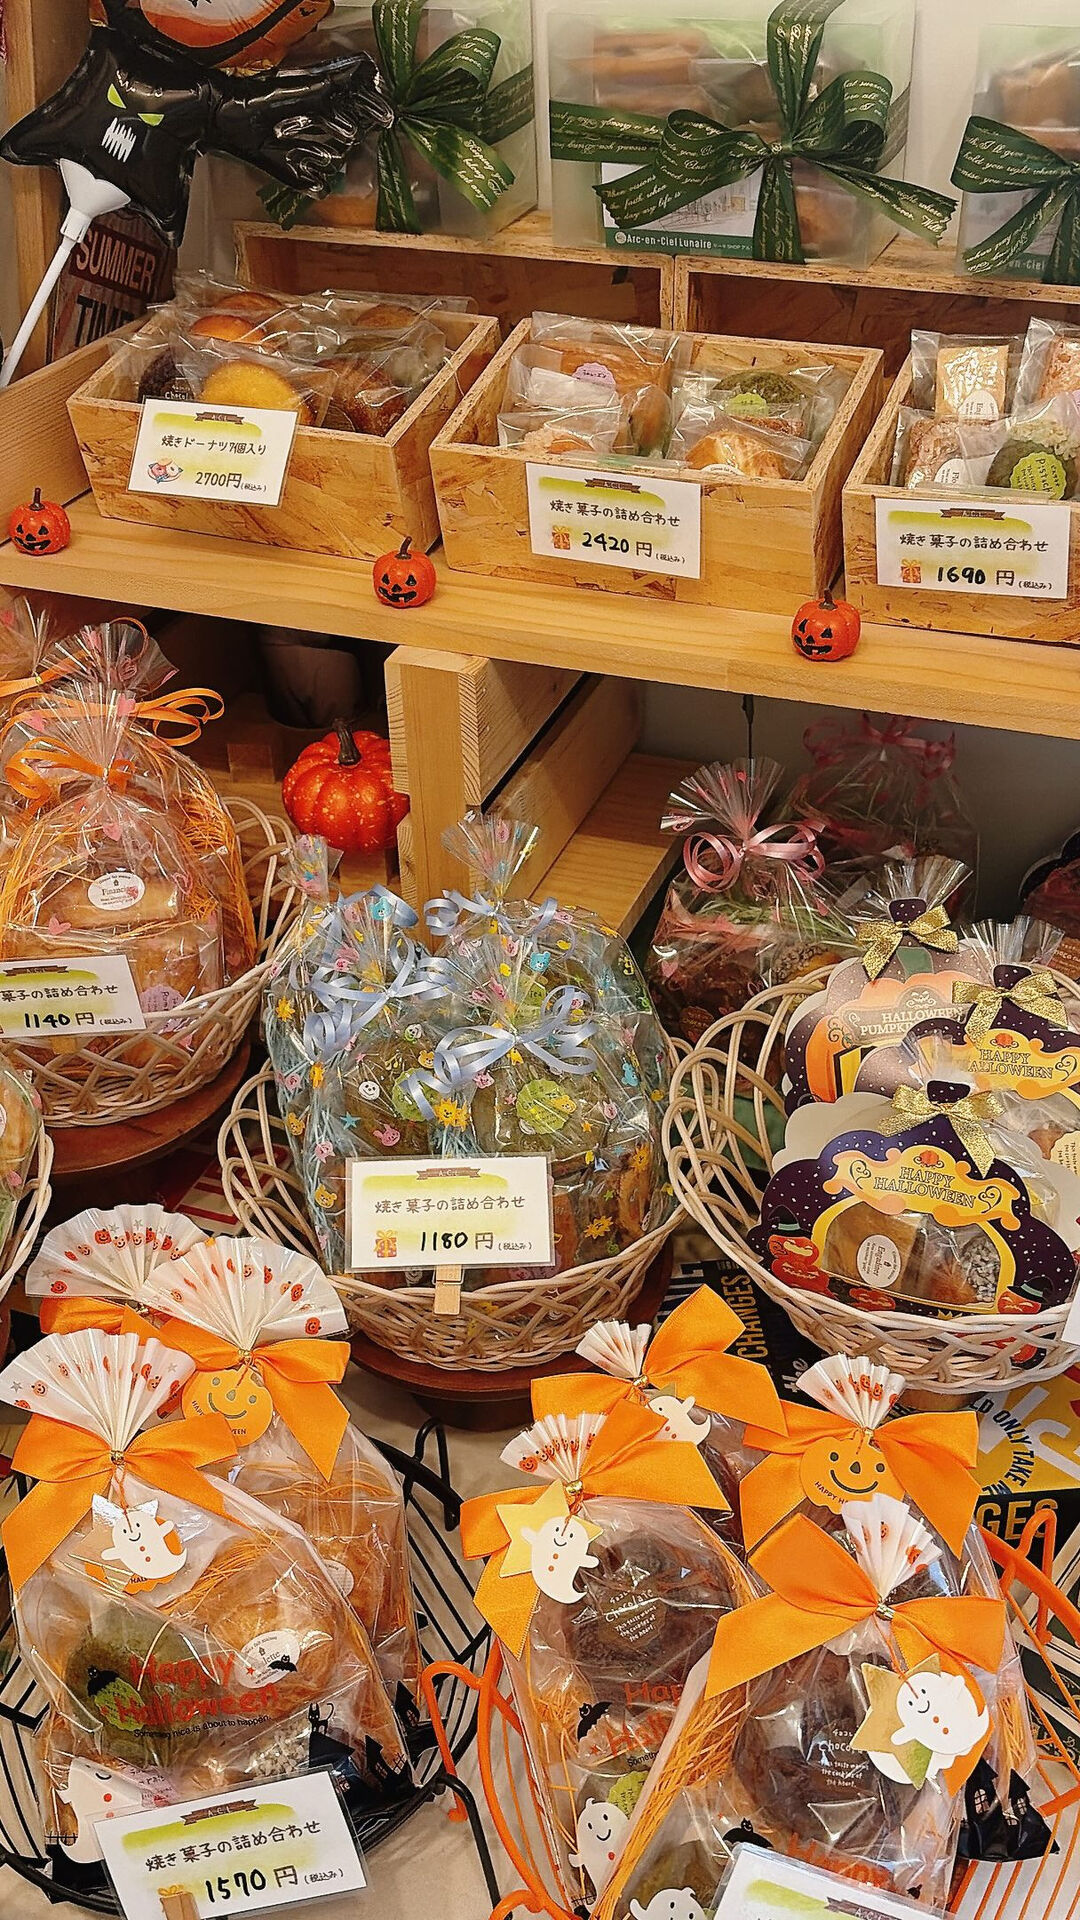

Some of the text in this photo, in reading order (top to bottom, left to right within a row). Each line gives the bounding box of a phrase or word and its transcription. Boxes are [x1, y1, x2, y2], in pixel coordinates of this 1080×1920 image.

[76, 228, 156, 296] SUMMER
[161, 434, 268, 456] 焼きドーナツ7個入り
[549, 499, 681, 528] 焼き菓子の詰め合わせ
[581, 531, 630, 554] 2420
[635, 541, 653, 558] 円
[899, 532, 1050, 553] 焼き菓子の詰め合わせ
[937, 566, 986, 585] 1690
[996, 570, 1015, 587] 円
[0, 984, 119, 1003] 菓子の詰め合わせ
[24, 1013, 71, 1029] 1140
[75, 1012, 95, 1026] 円
[882, 1005, 964, 1024] HALLOWEEN
[980, 1047, 1032, 1065] HAPPY
[966, 1059, 1054, 1080] ALLOWEEN
[900, 1166, 956, 1189] HAPPY
[374, 1195, 526, 1214] 焼き菓子の詰め合わせ
[873, 1177, 977, 1209] HALLOWEEN
[420, 1231, 468, 1252] 1180
[475, 1232, 494, 1250] 円
[720, 1274, 769, 1359] CHANGES
[992, 1411, 1033, 1446] ONLY
[1003, 1449, 1035, 1488] TAKE
[128, 1651, 236, 1694] Happy
[112, 1684, 279, 1728] Halloween
[172, 1726, 191, 1738] nice
[191, 1724, 200, 1735] is
[202, 1718, 227, 1731] about
[227, 1718, 237, 1728] to
[145, 1820, 322, 1873] 焼き菓子の詰め合わせ
[205, 1868, 267, 1903] 1570
[273, 1864, 298, 1889] 円
